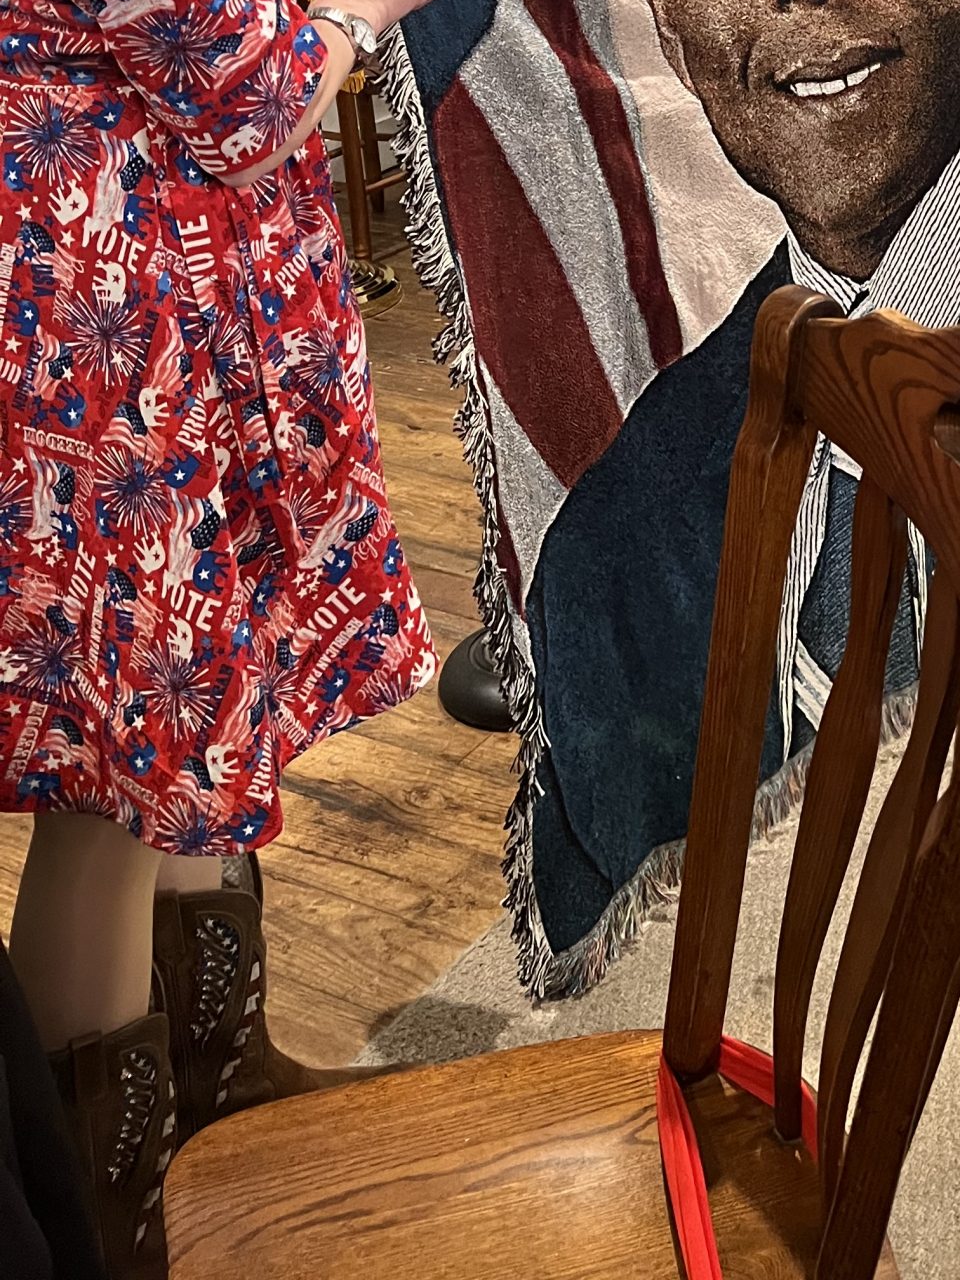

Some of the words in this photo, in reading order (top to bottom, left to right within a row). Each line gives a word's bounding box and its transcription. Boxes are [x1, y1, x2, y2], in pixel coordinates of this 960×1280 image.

[183, 132, 229, 172] OTE
[82, 216, 147, 274] VOTE
[66, 541, 97, 606] VOTE
[161, 569, 222, 632] VOTE
[304, 577, 367, 633] VOTE
[316, 616, 364, 665] REPUBLICAN
[298, 661, 326, 702] PARTY
